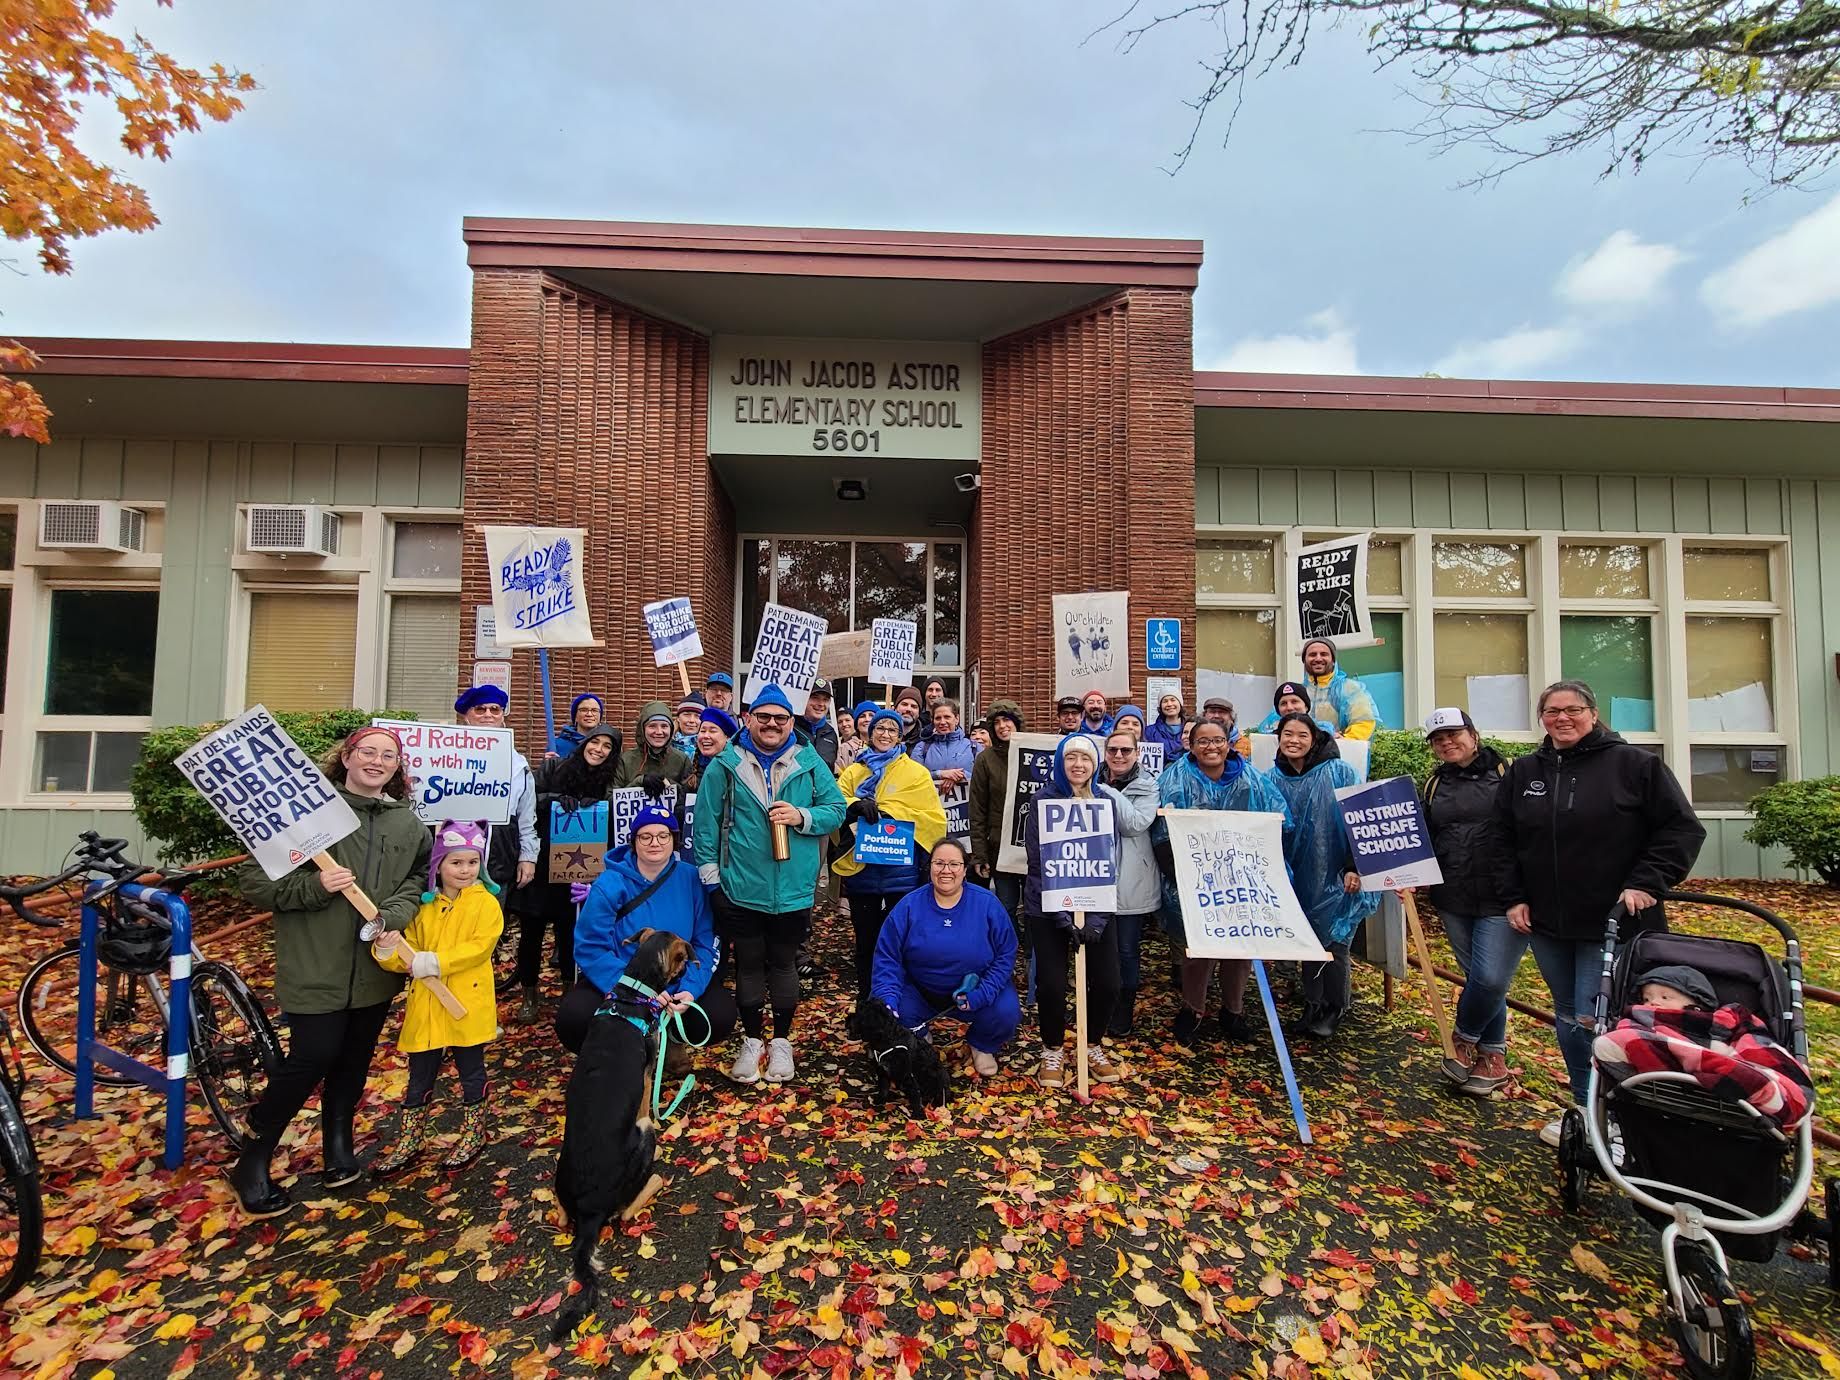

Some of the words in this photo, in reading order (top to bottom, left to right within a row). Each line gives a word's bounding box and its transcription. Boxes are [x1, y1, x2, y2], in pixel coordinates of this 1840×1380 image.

[730, 358, 791, 386] JOHN
[802, 360, 876, 389] JACOB
[887, 362, 960, 392] ASTOR
[735, 395, 876, 426] ELEMENTARY
[882, 400, 963, 429] SCHOOL
[812, 429, 880, 452] 5601
[502, 546, 553, 586] READY
[1301, 549, 1352, 570] READY
[1315, 565, 1335, 579] TO
[526, 581, 546, 600] TO
[1299, 573, 1352, 594] STRIKE
[514, 586, 574, 629] STRIKE
[647, 613, 661, 624] ON
[660, 606, 691, 621] STRIKE
[653, 620, 672, 631] FOR
[671, 614, 690, 626] OUR
[767, 607, 782, 618] PAT
[783, 612, 824, 631] DEMANDS
[886, 621, 915, 630] DEMANDS
[1065, 611, 1083, 626] Our
[651, 620, 695, 640] STUDENTS
[763, 617, 823, 648] GREAT
[874, 626, 915, 641] GREAT
[758, 635, 819, 664] PUBLIC
[872, 648, 912, 661] SCHOOLS
[873, 638, 913, 652] PUBLIC
[755, 652, 816, 677] SCHOOLS
[870, 657, 891, 668] FOR
[893, 660, 911, 670] ALL
[751, 665, 781, 684] FOR
[783, 673, 810, 691] ALL
[182, 751, 204, 773] PAT
[202, 712, 270, 758] DEMANDS
[428, 728, 499, 751] Rather
[193, 723, 286, 794] GREAT
[430, 753, 462, 769] with
[466, 758, 487, 773] my
[209, 747, 306, 816] PUBLIC
[423, 772, 511, 804] Students
[229, 767, 320, 831] SCHOOLS
[616, 791, 632, 800] PAT
[241, 812, 290, 850] FOR
[288, 784, 336, 822] ALL
[1045, 804, 1104, 833] PAT
[1344, 809, 1366, 825] ON
[1365, 801, 1417, 822] STRIKE
[878, 824, 882, 834] I
[1352, 824, 1380, 840] FOR
[1380, 817, 1419, 836] SAFE
[860, 843, 909, 855] Educators
[864, 834, 906, 845] Portland
[1187, 830, 1265, 849] DIVERSE
[1358, 834, 1422, 855] SCHOOLS
[1062, 842, 1087, 860] ON
[1191, 844, 1269, 867] students
[1045, 860, 1111, 878] STRIKE
[1198, 887, 1281, 909] DESERVE
[1205, 919, 1295, 939] teachers
